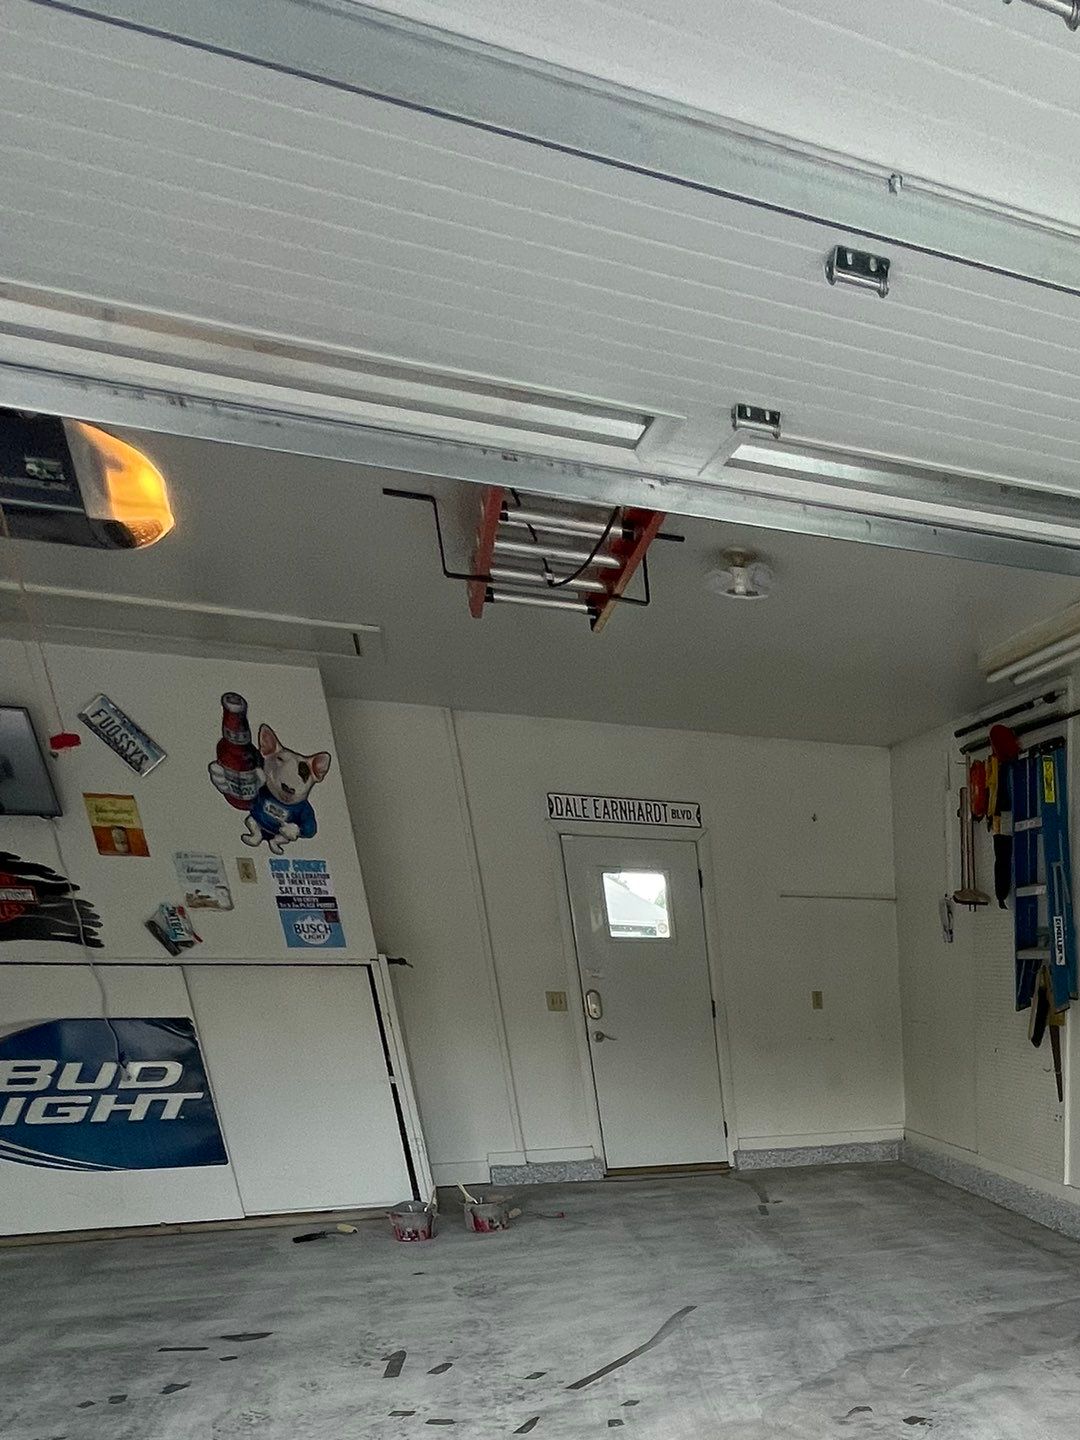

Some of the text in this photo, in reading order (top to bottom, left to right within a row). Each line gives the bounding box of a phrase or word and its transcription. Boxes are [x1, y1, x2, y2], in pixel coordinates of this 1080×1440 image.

[554, 796, 692, 823] DALE EARNHARDT BLVD
[297, 886, 312, 895] FEB
[293, 923, 333, 934] BUSCH
[0, 1059, 183, 1092] BUD
[0, 1092, 204, 1126] IGHT
